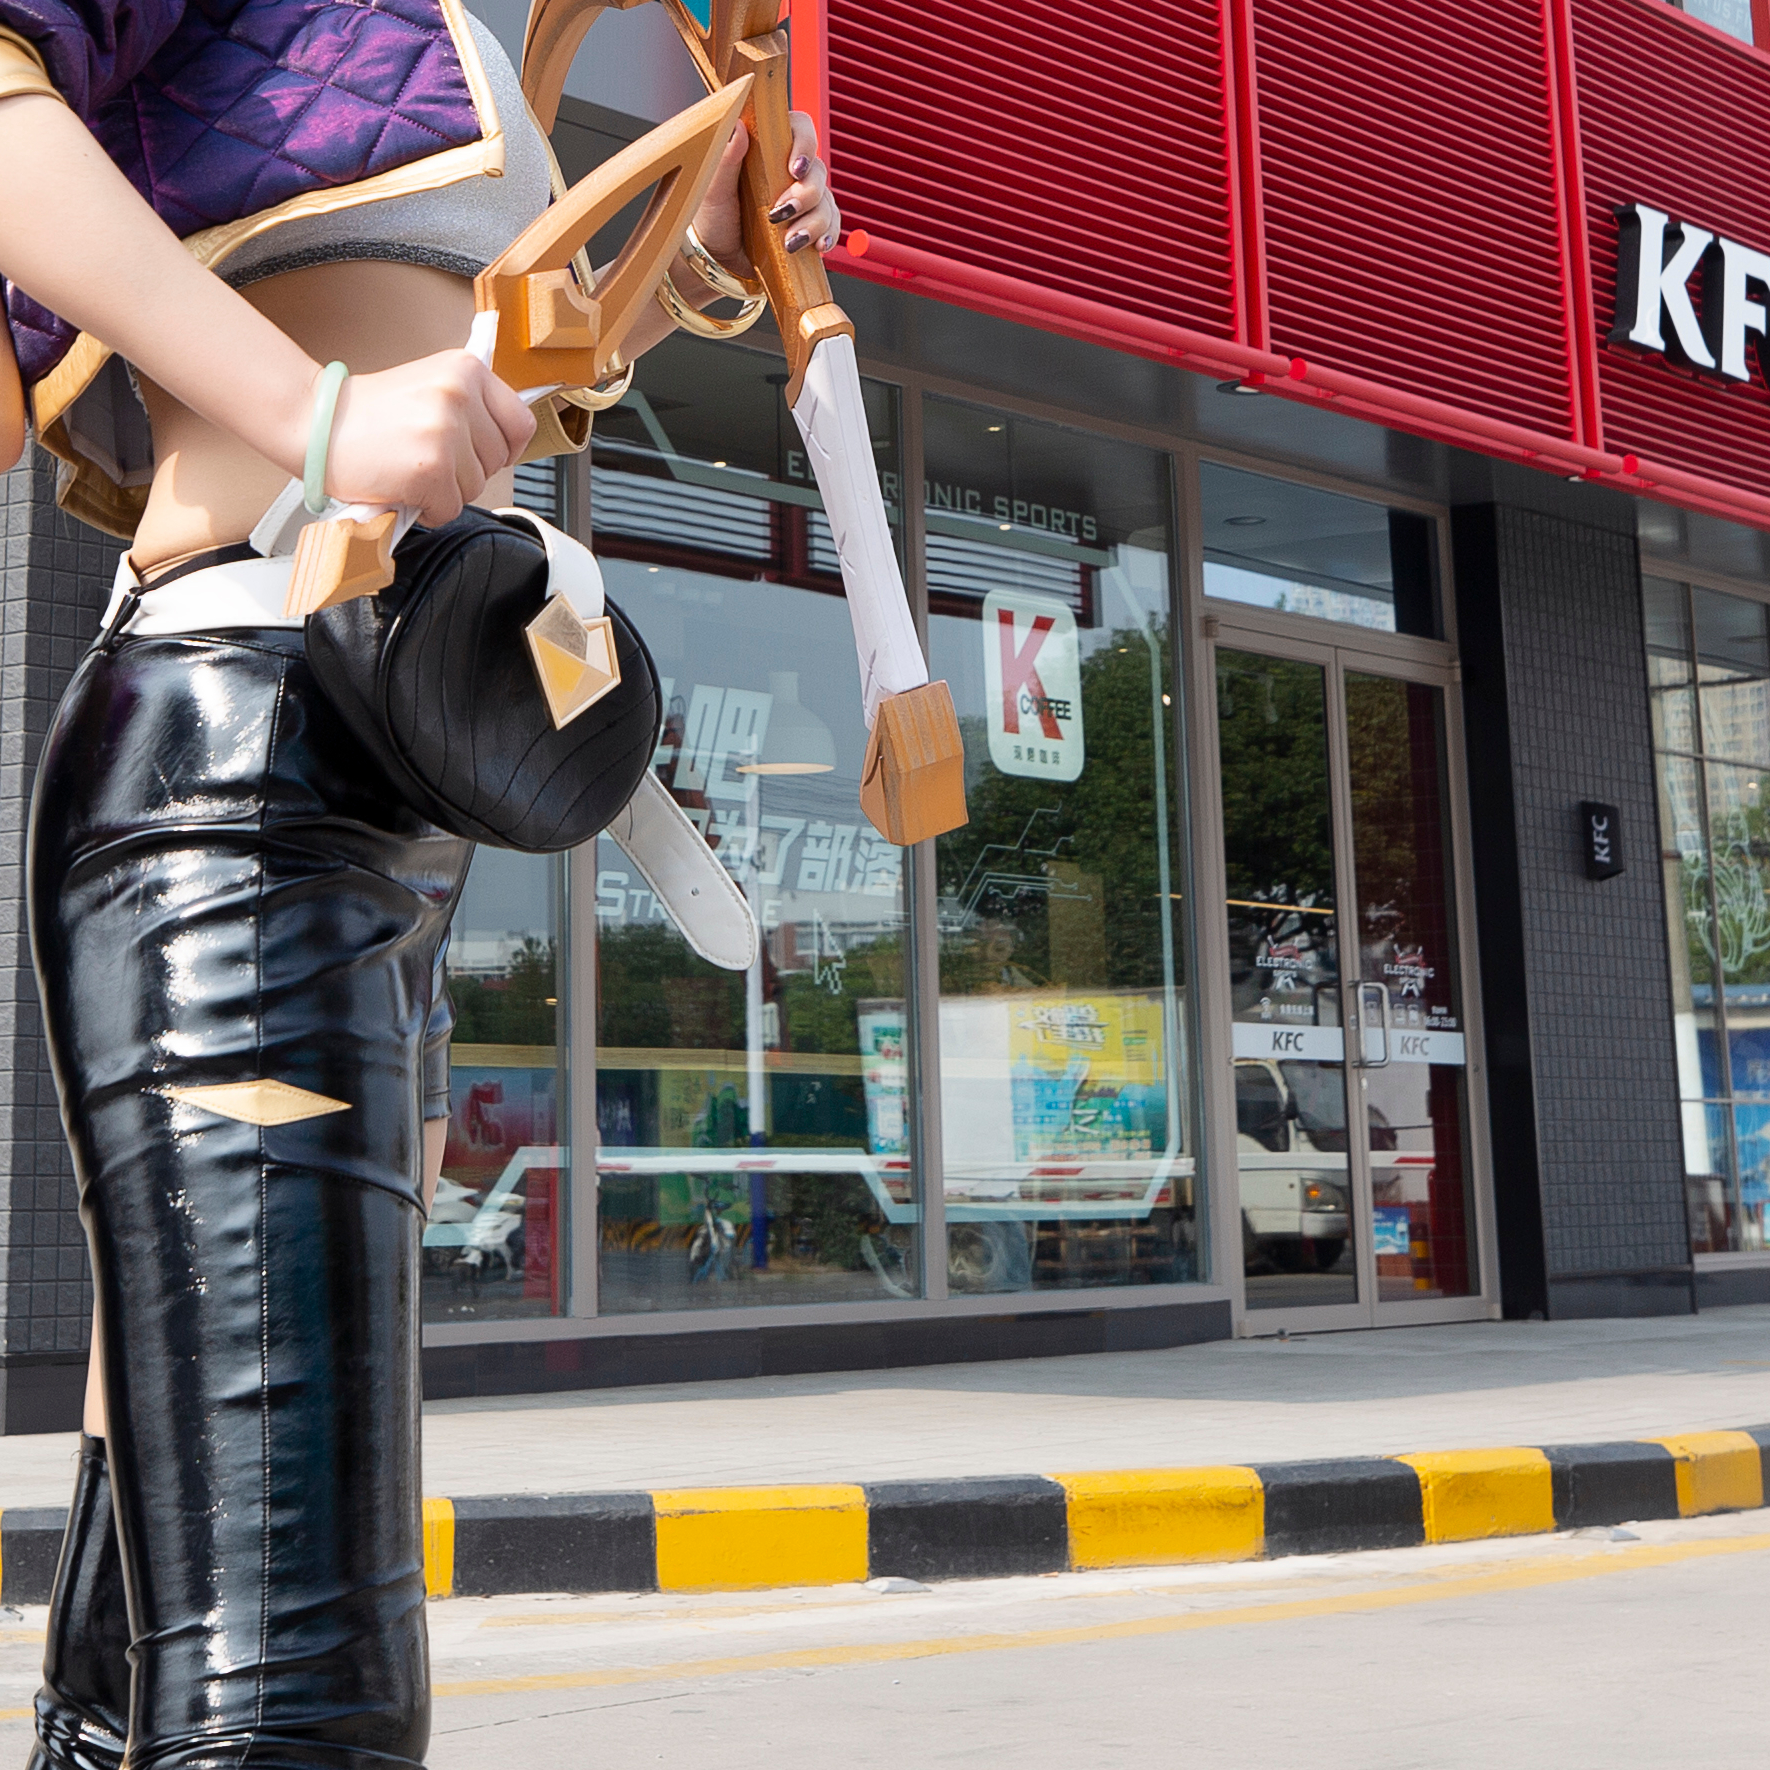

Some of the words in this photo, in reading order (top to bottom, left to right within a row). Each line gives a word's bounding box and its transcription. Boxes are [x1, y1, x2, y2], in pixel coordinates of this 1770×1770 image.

[993, 495, 1098, 541] SPORTS
[998, 608, 1065, 741] K
[1020, 694, 1072, 721] COFFEE
[1591, 815, 1611, 864] KFC
[1272, 1032, 1305, 1052] KFC
[1400, 1036, 1431, 1056] KFC
